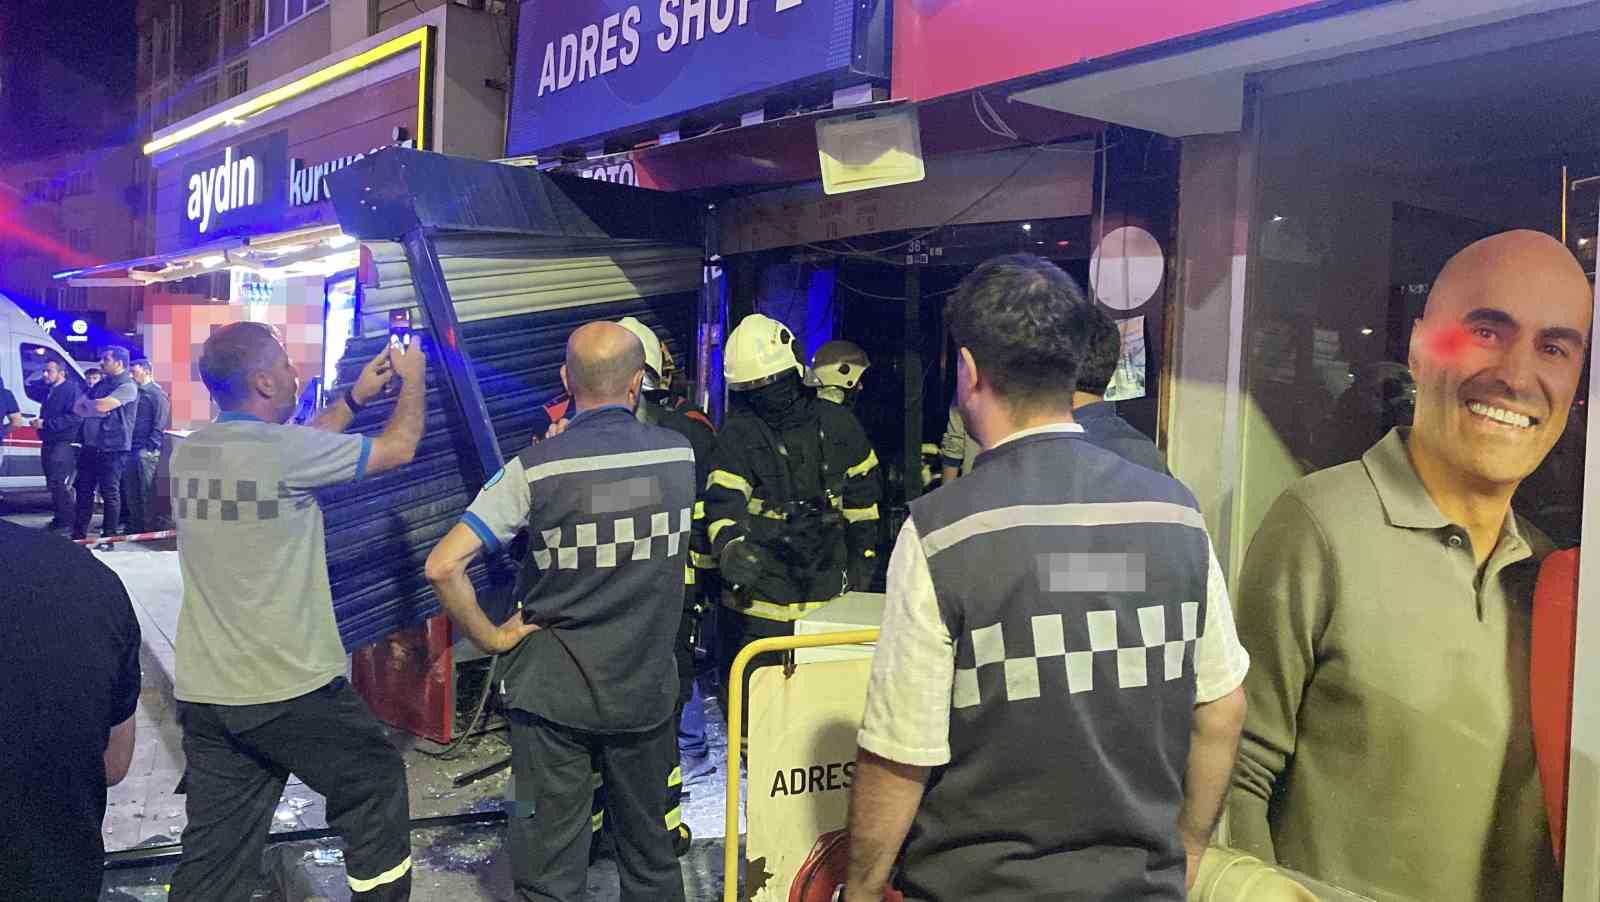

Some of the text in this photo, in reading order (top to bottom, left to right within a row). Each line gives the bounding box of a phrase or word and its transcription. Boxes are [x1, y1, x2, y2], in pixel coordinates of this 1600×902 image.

[538, 5, 641, 97] ADRES
[187, 146, 255, 233] aydın
[770, 761, 856, 798] ADRES
